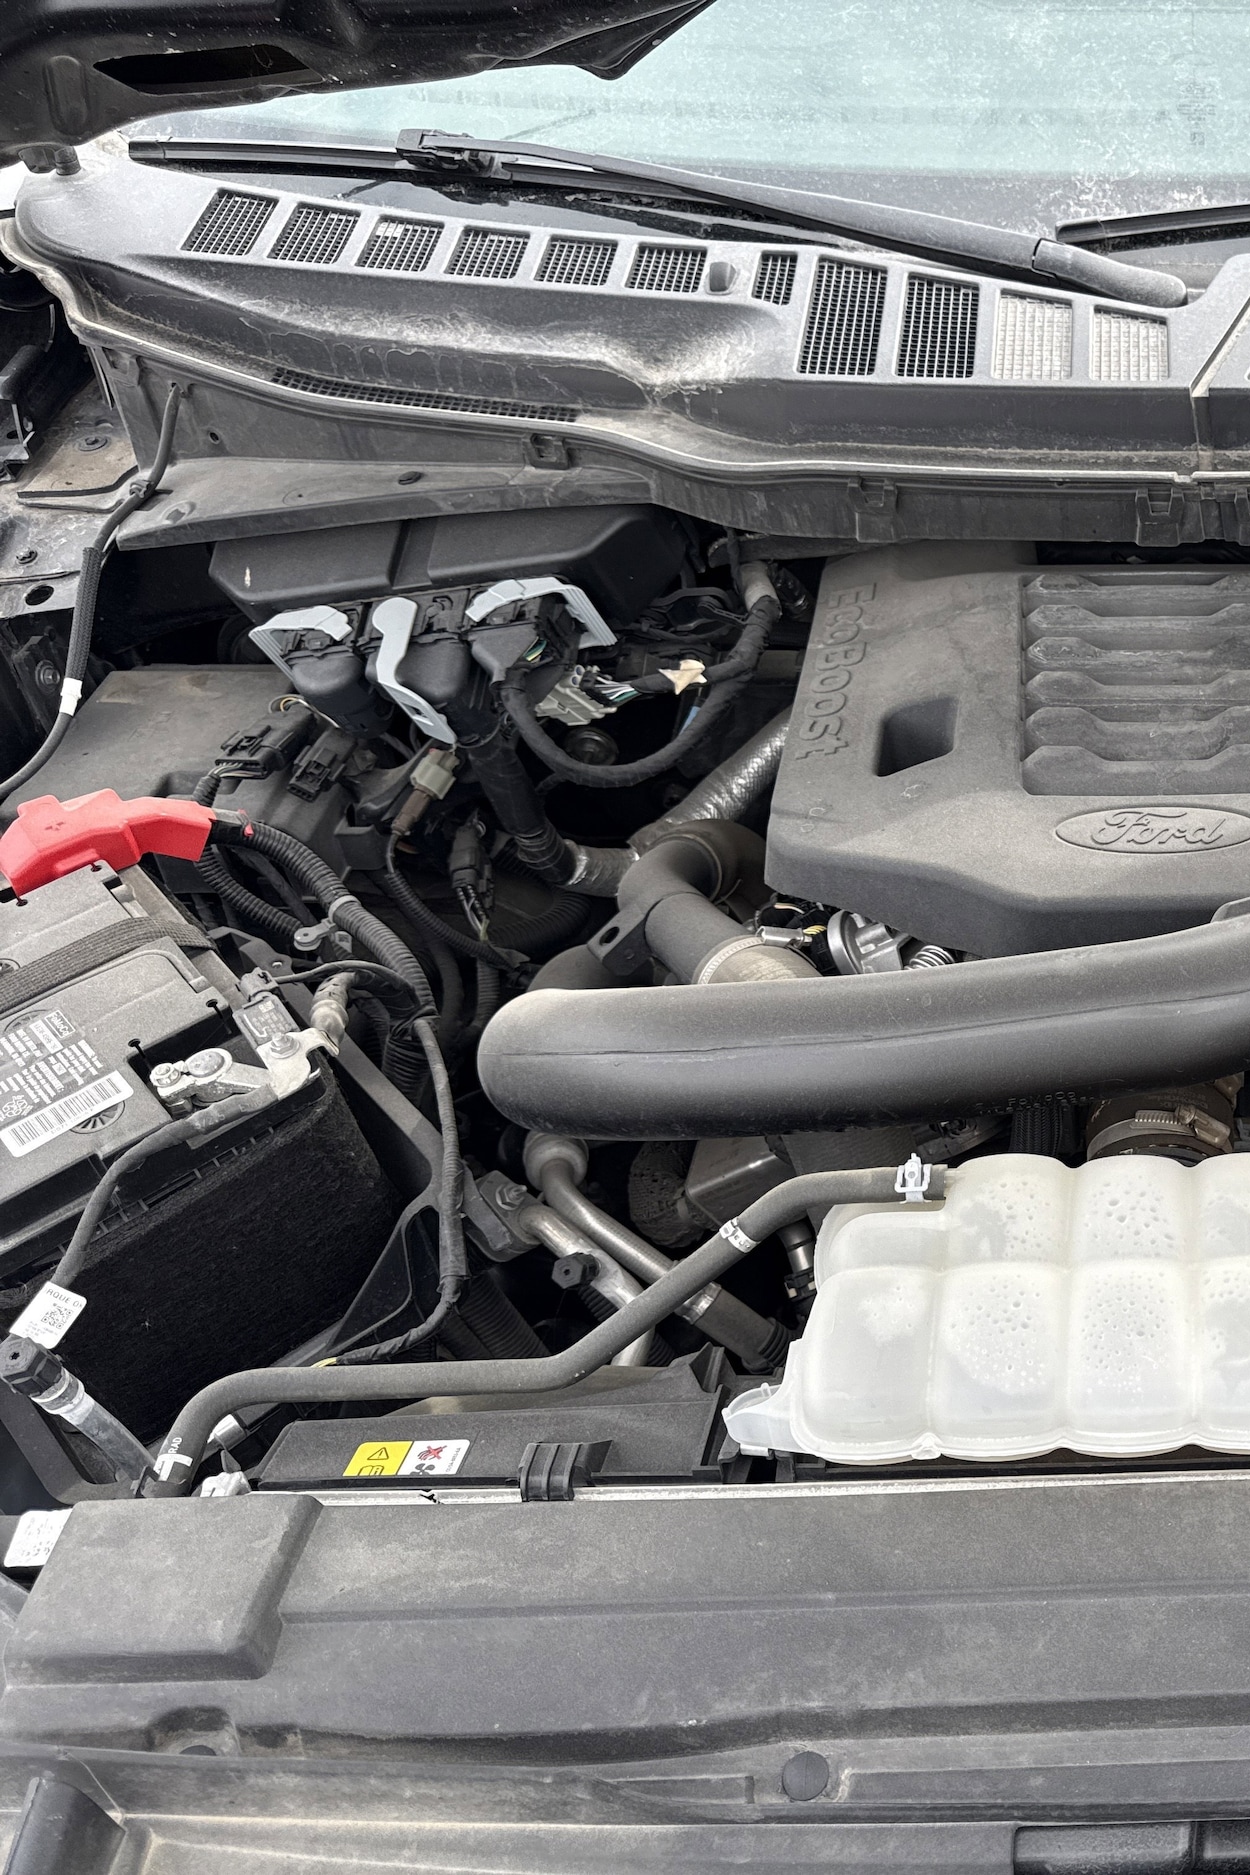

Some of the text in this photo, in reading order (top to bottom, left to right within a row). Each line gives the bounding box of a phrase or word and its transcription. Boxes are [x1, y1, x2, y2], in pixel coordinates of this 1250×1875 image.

[796, 582, 877, 760] EcoBoost
[1091, 811, 1226, 845] Ford
[167, 1437, 183, 1454] RAD
